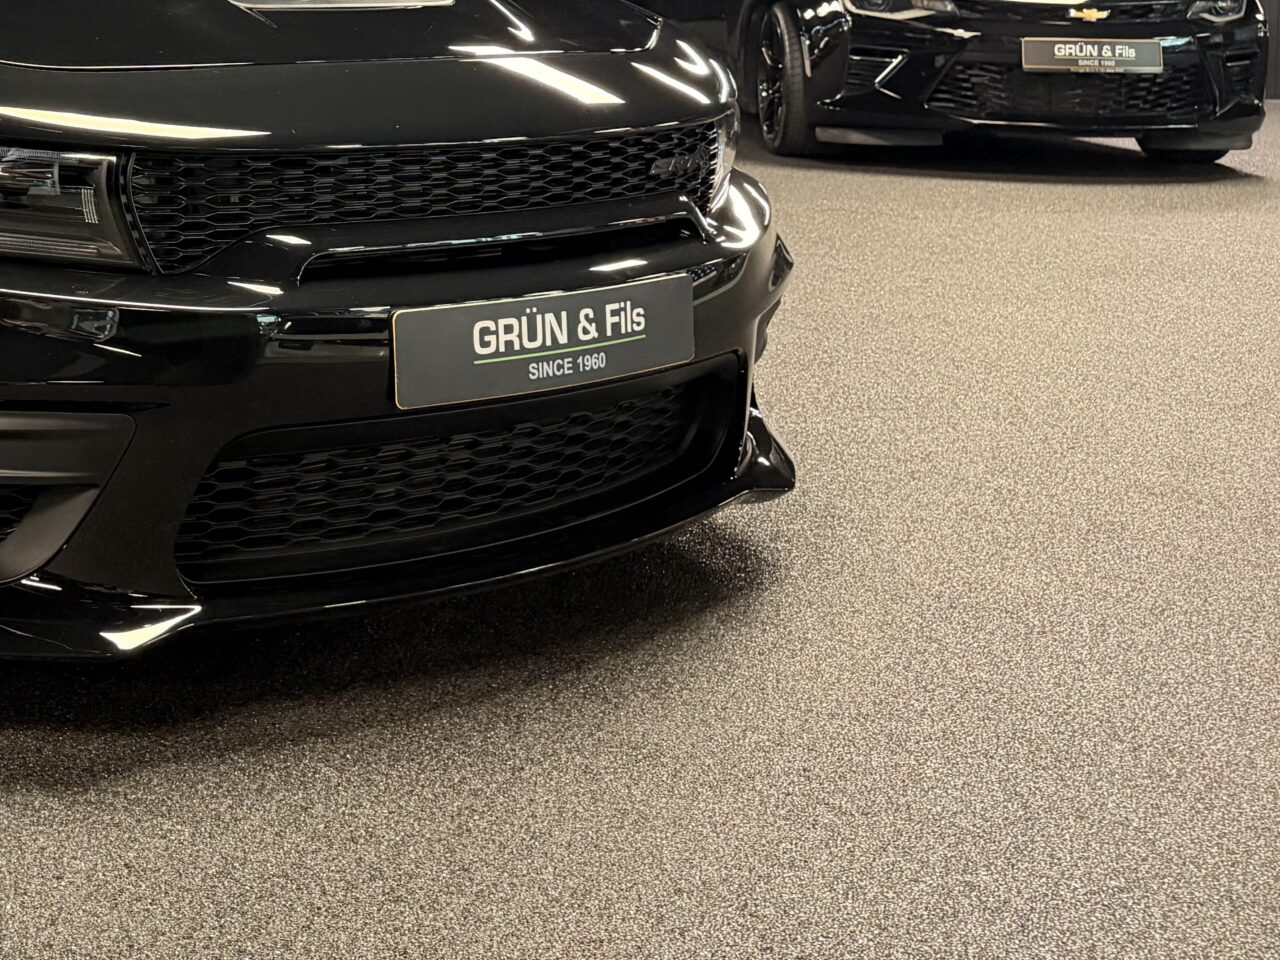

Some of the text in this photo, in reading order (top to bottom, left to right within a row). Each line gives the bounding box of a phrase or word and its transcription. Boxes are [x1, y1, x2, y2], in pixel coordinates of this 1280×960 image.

[1054, 42, 1136, 57] GRÜN & Fils
[472, 300, 646, 355] GRÜN & Fils
[528, 351, 607, 380] SINCE 1960
